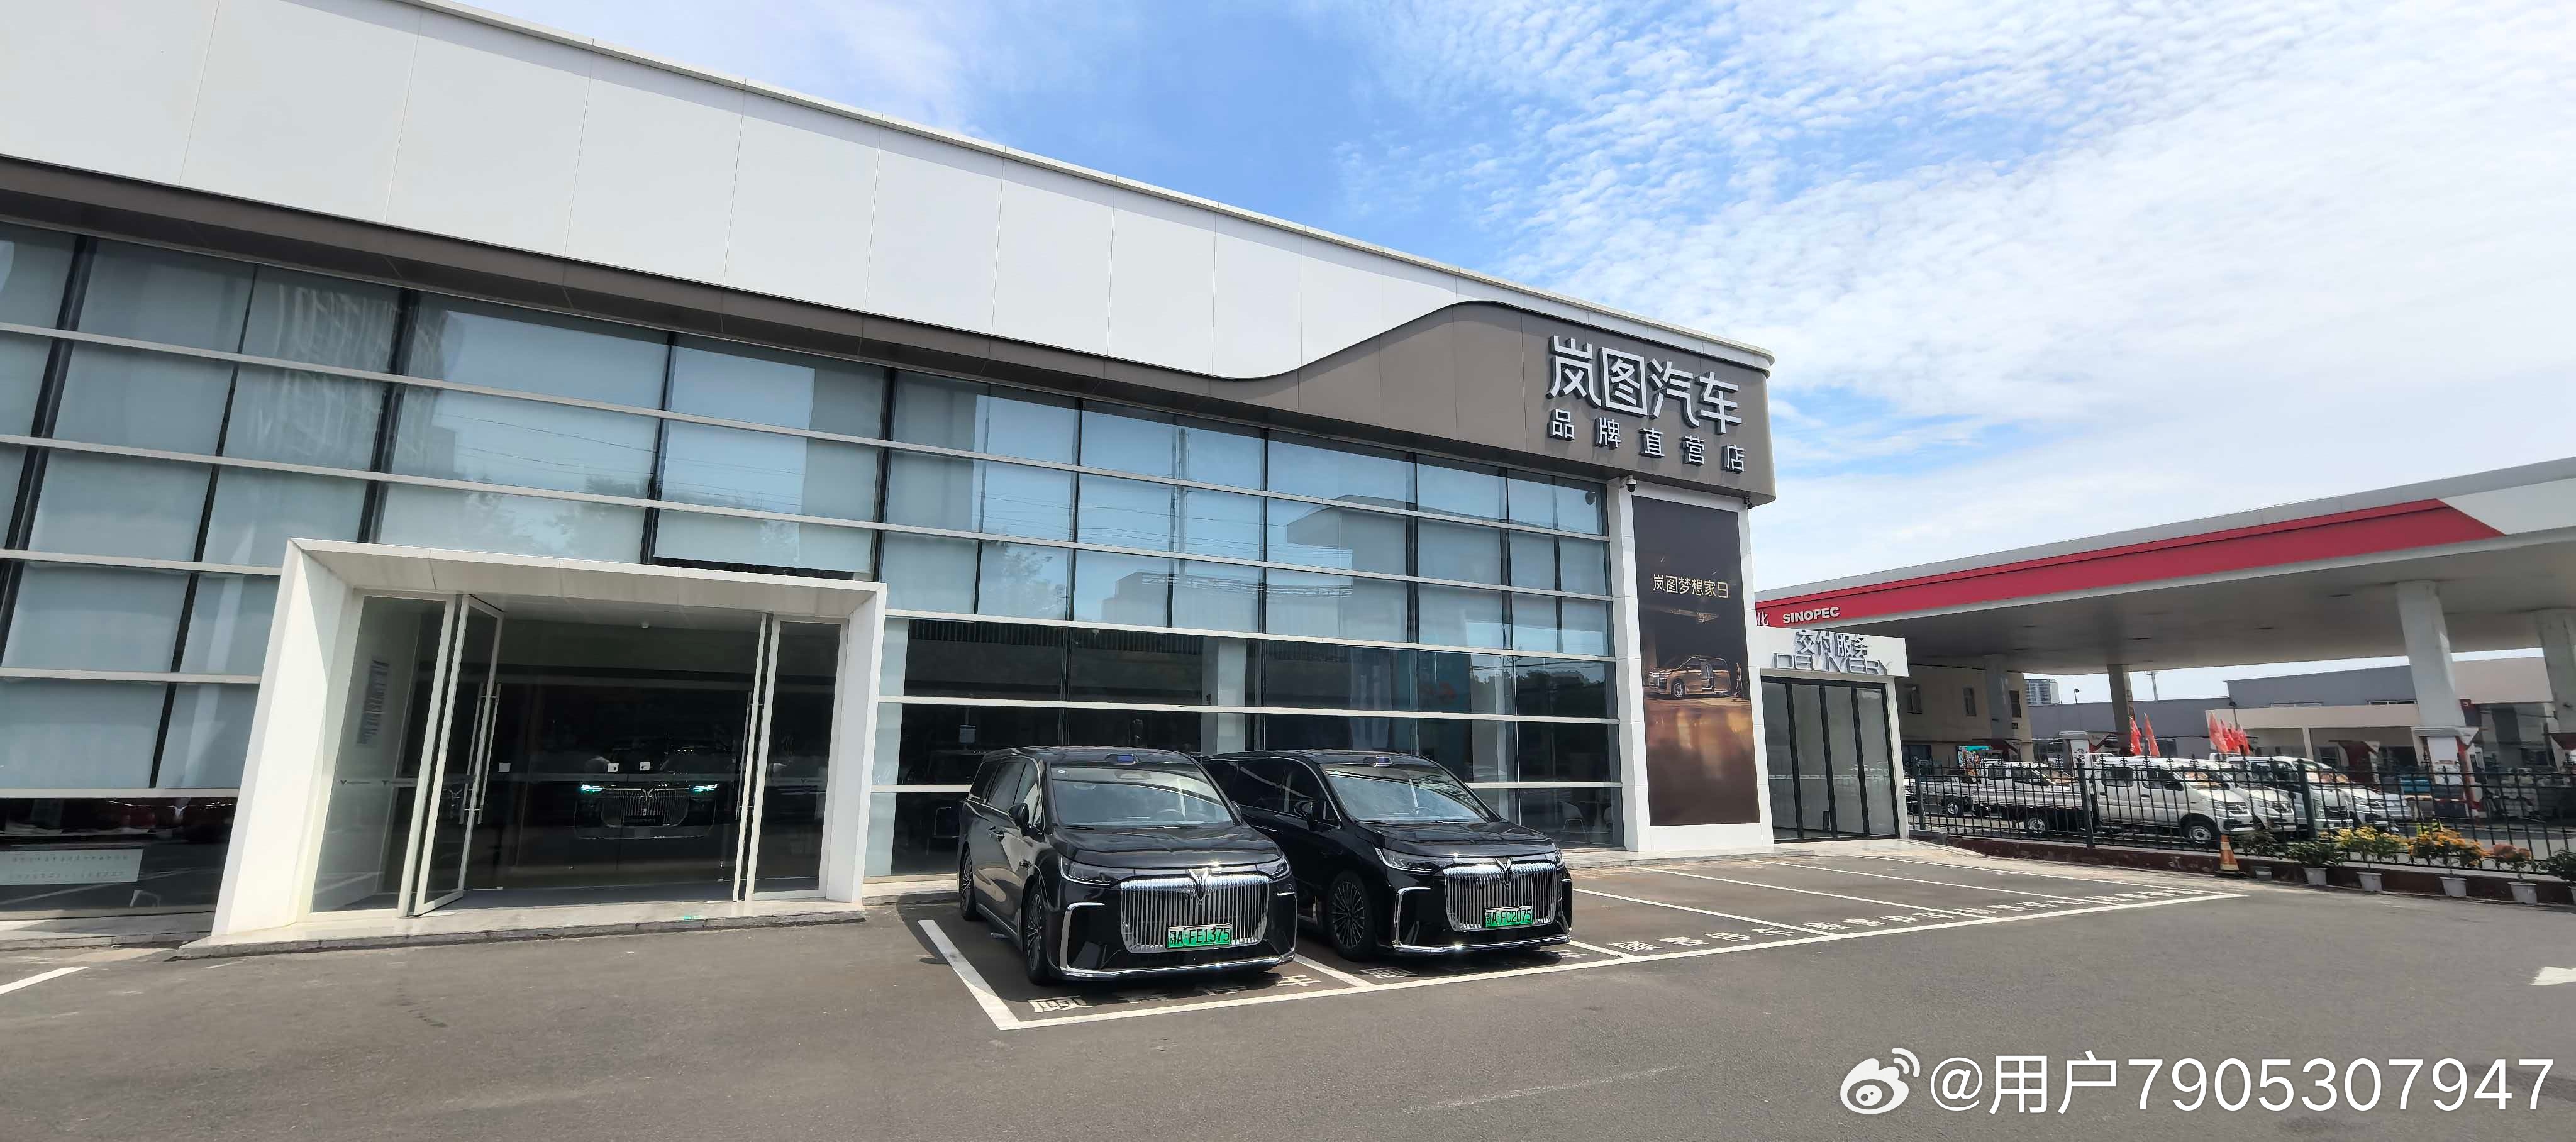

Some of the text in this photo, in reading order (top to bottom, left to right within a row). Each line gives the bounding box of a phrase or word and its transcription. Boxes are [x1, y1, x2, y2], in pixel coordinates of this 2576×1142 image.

[1546, 335, 1742, 435] 岚图汽车
[1549, 409, 1745, 474] 品牌直营店
[1782, 606, 1840, 624] SINOPEC
[1795, 629, 1868, 658] 交付服务
[1775, 652, 1894, 676] DELIVERY
